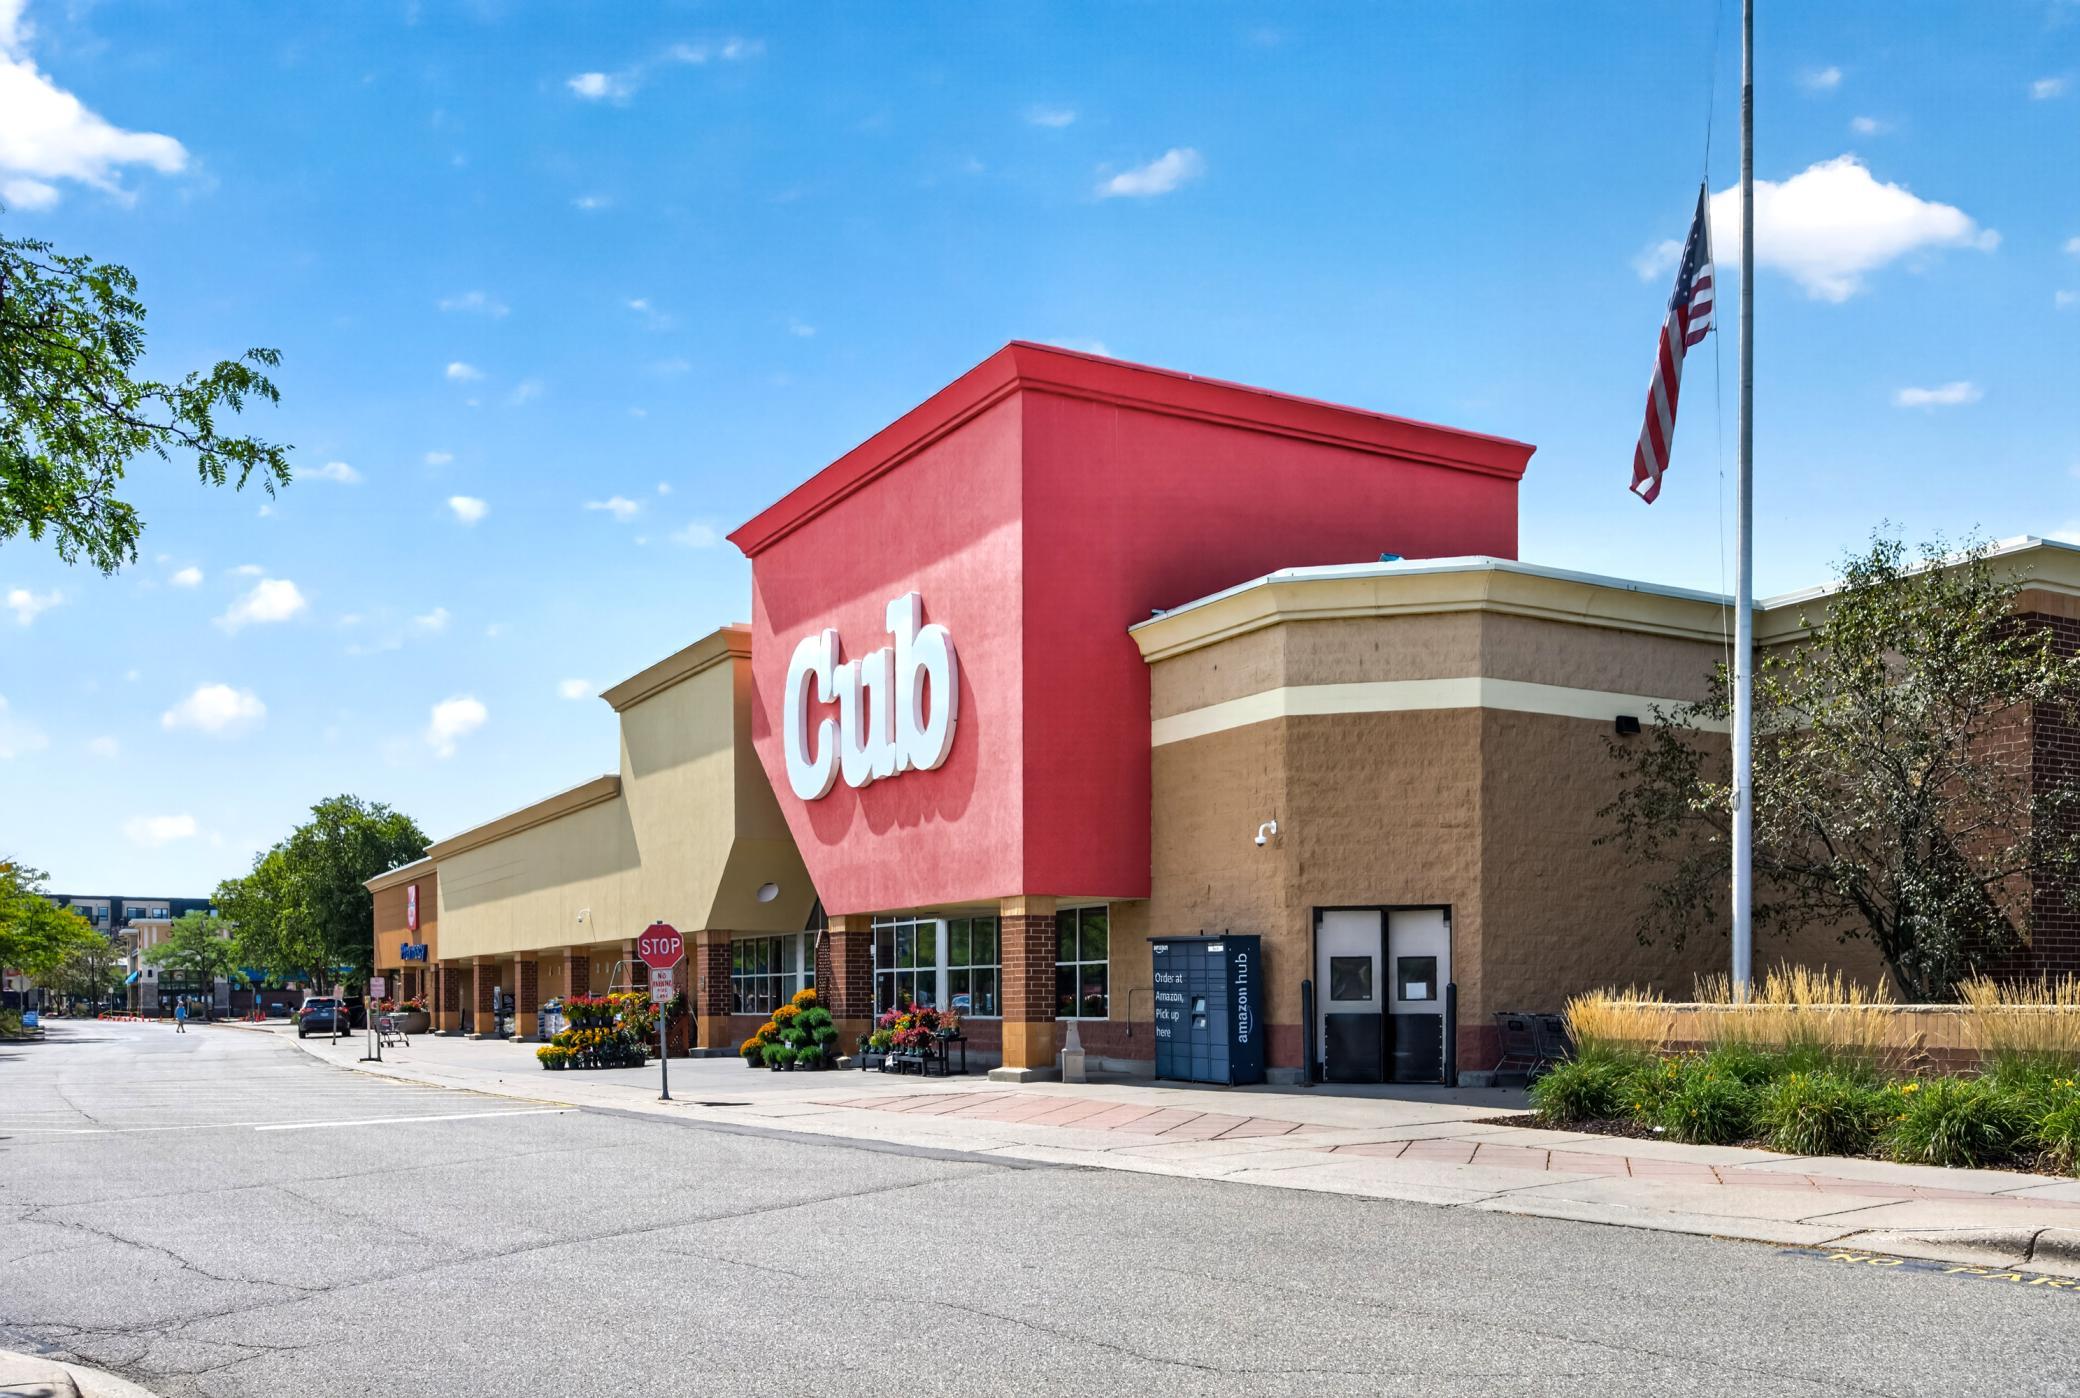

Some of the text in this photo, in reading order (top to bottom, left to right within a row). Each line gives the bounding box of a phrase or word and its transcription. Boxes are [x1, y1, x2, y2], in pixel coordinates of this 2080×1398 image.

[784, 591, 959, 800] Cub
[641, 937, 680, 955] STOP
[1155, 972, 1183, 983] Order at
[1156, 991, 1184, 1003] Amazon,
[1235, 953, 1248, 1043] amazon hub
[1156, 1009, 1179, 1022] Pick up
[1156, 1026, 1171, 1037] here
[1827, 1253, 1904, 1266] NO
